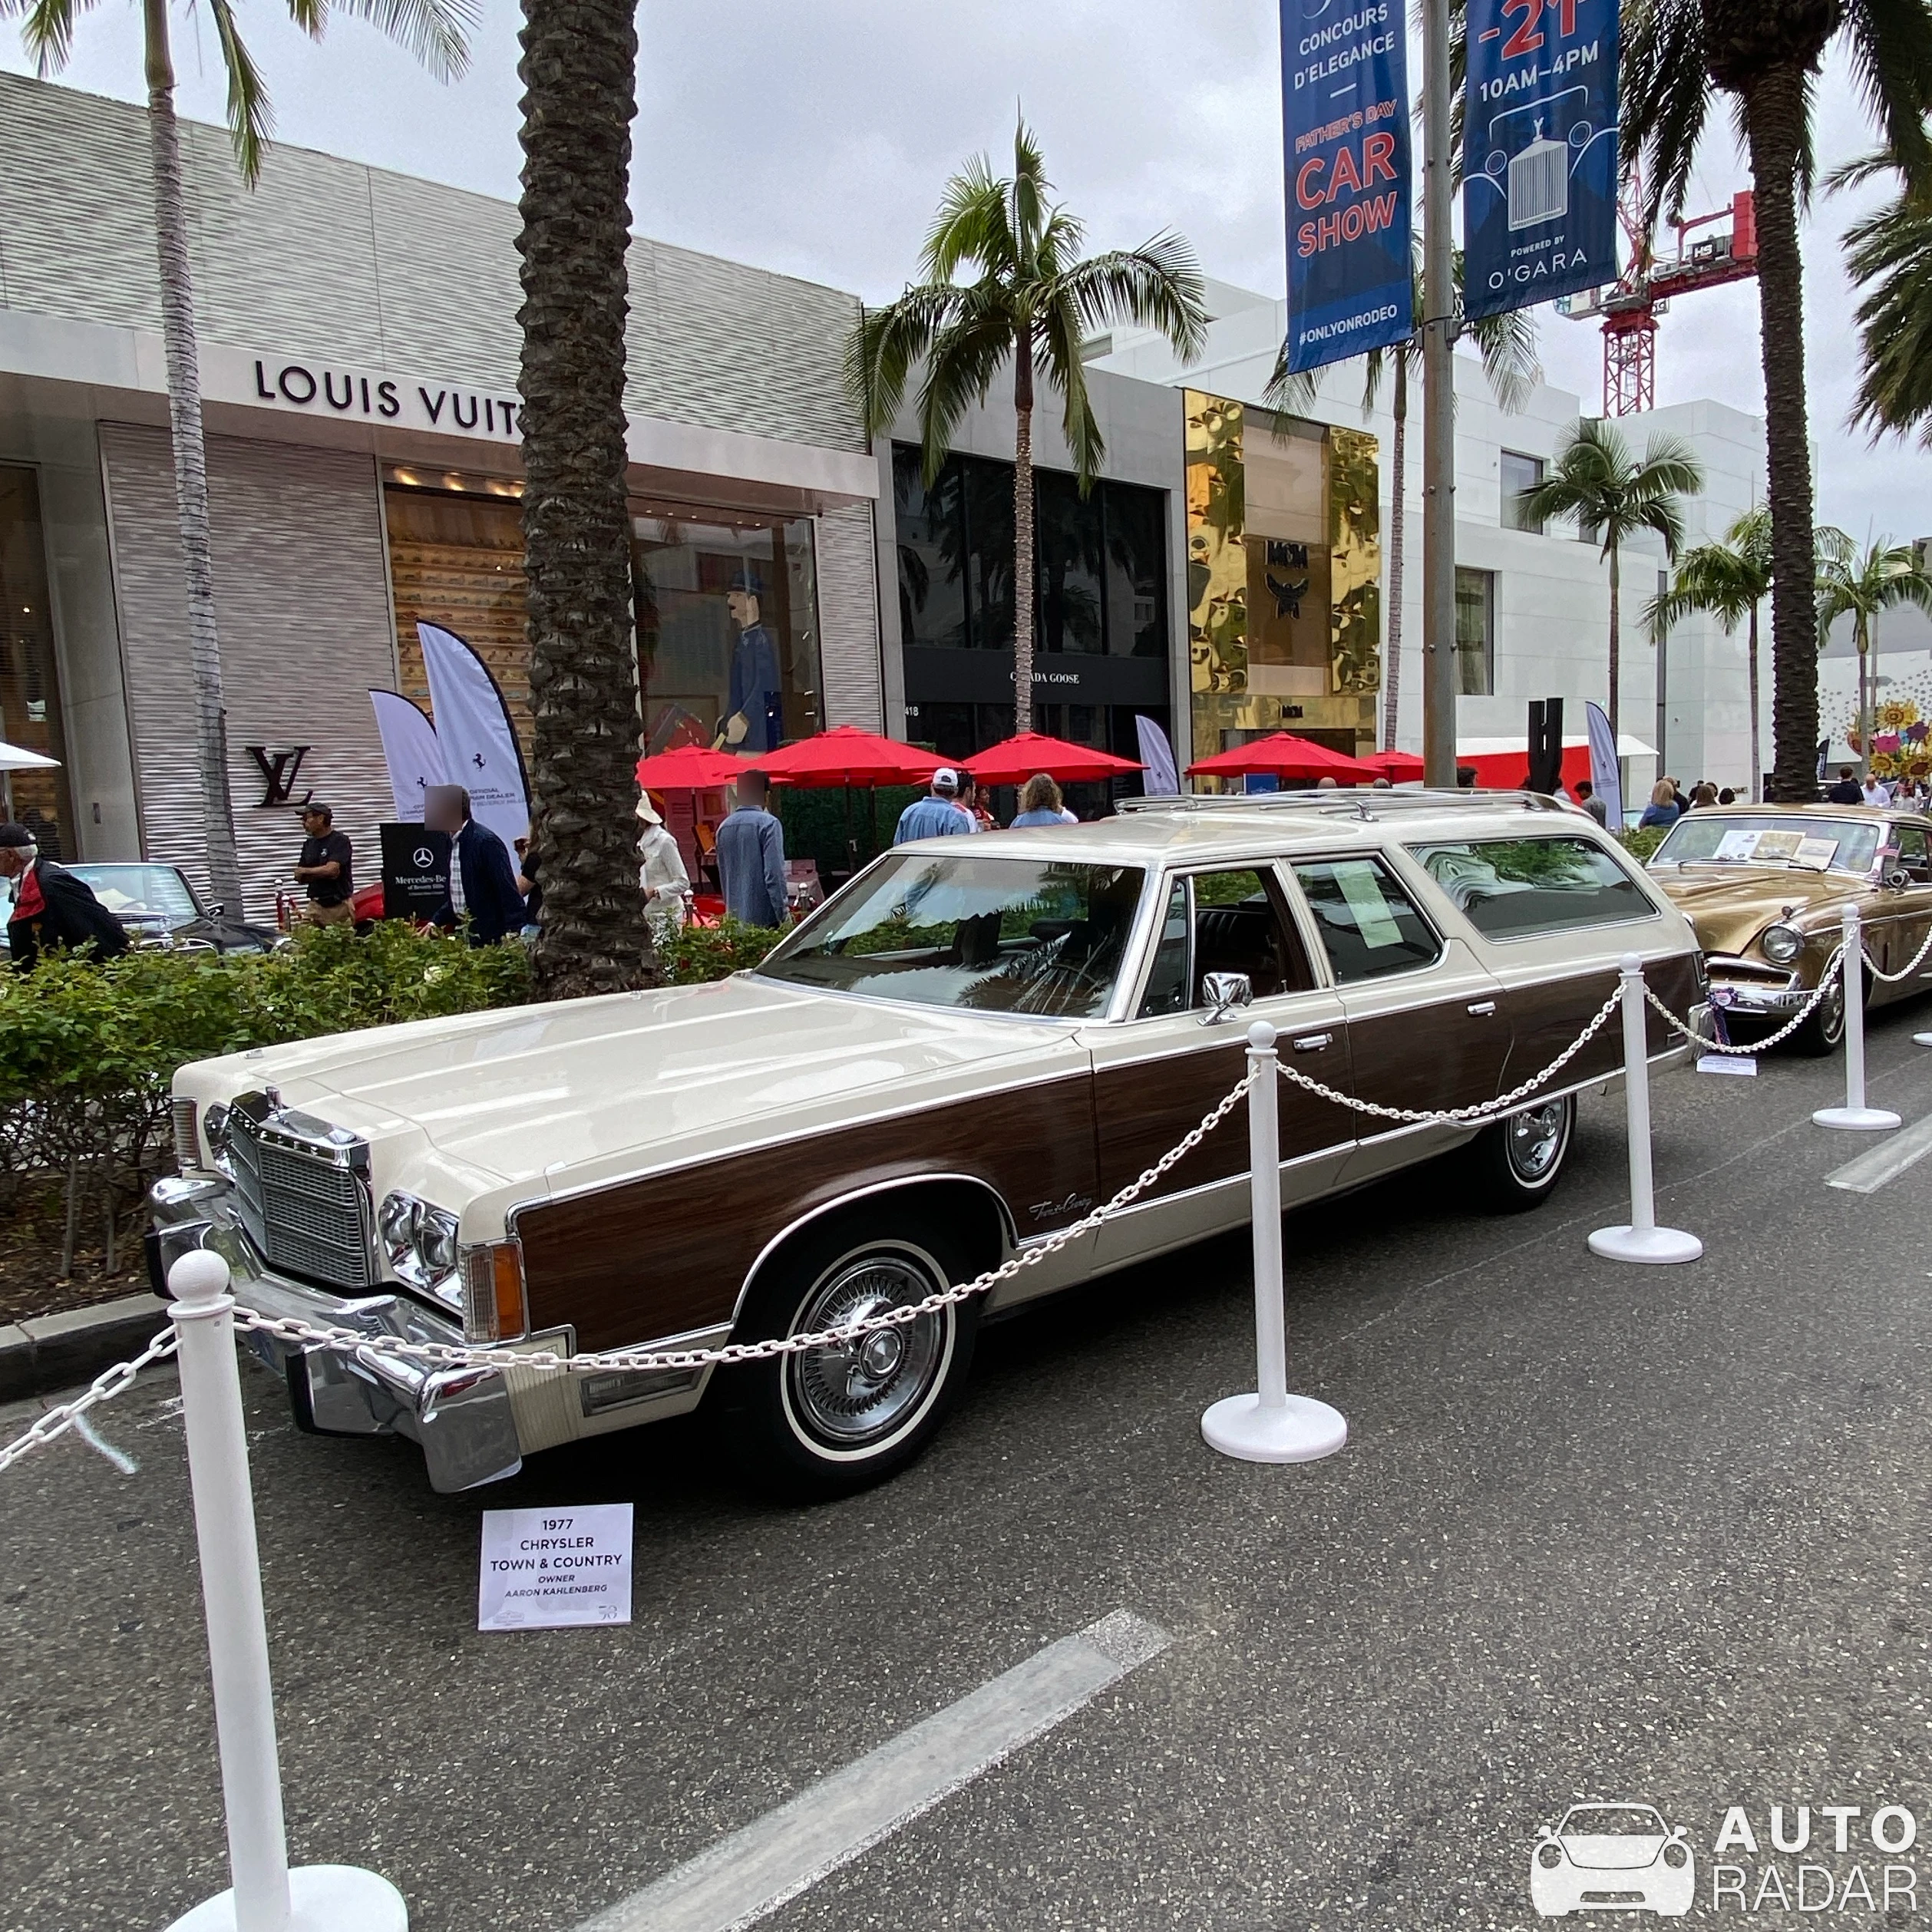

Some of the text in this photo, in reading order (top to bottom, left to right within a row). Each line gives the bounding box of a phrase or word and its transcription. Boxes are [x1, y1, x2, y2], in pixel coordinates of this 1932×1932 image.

[1299, 2, 1389, 56] CONCOURS
[1294, 31, 1395, 91] D'ELEGANCE
[1295, 98, 1398, 154] FATHER'S DAY
[1296, 132, 1398, 210] CAR
[1297, 191, 1398, 258] SHOW
[1511, 234, 1565, 258] POWERED BY
[1488, 248, 1587, 289] O'GARA
[1299, 304, 1398, 346] #ONLYONRODEO
[256, 361, 524, 434] LOUIS VUIT
[1049, 673, 1080, 685] GOOSE
[905, 706, 919, 717] 418
[395, 875, 447, 884] Mercedes-Be
[543, 1519, 573, 1531] 1977
[520, 1537, 594, 1551] CHRYSLER
[490, 1554, 623, 1572] TOWN & COUNTRY
[504, 1584, 608, 1598] AARON KAHLENBERG
[538, 1574, 576, 1584] OWNER
